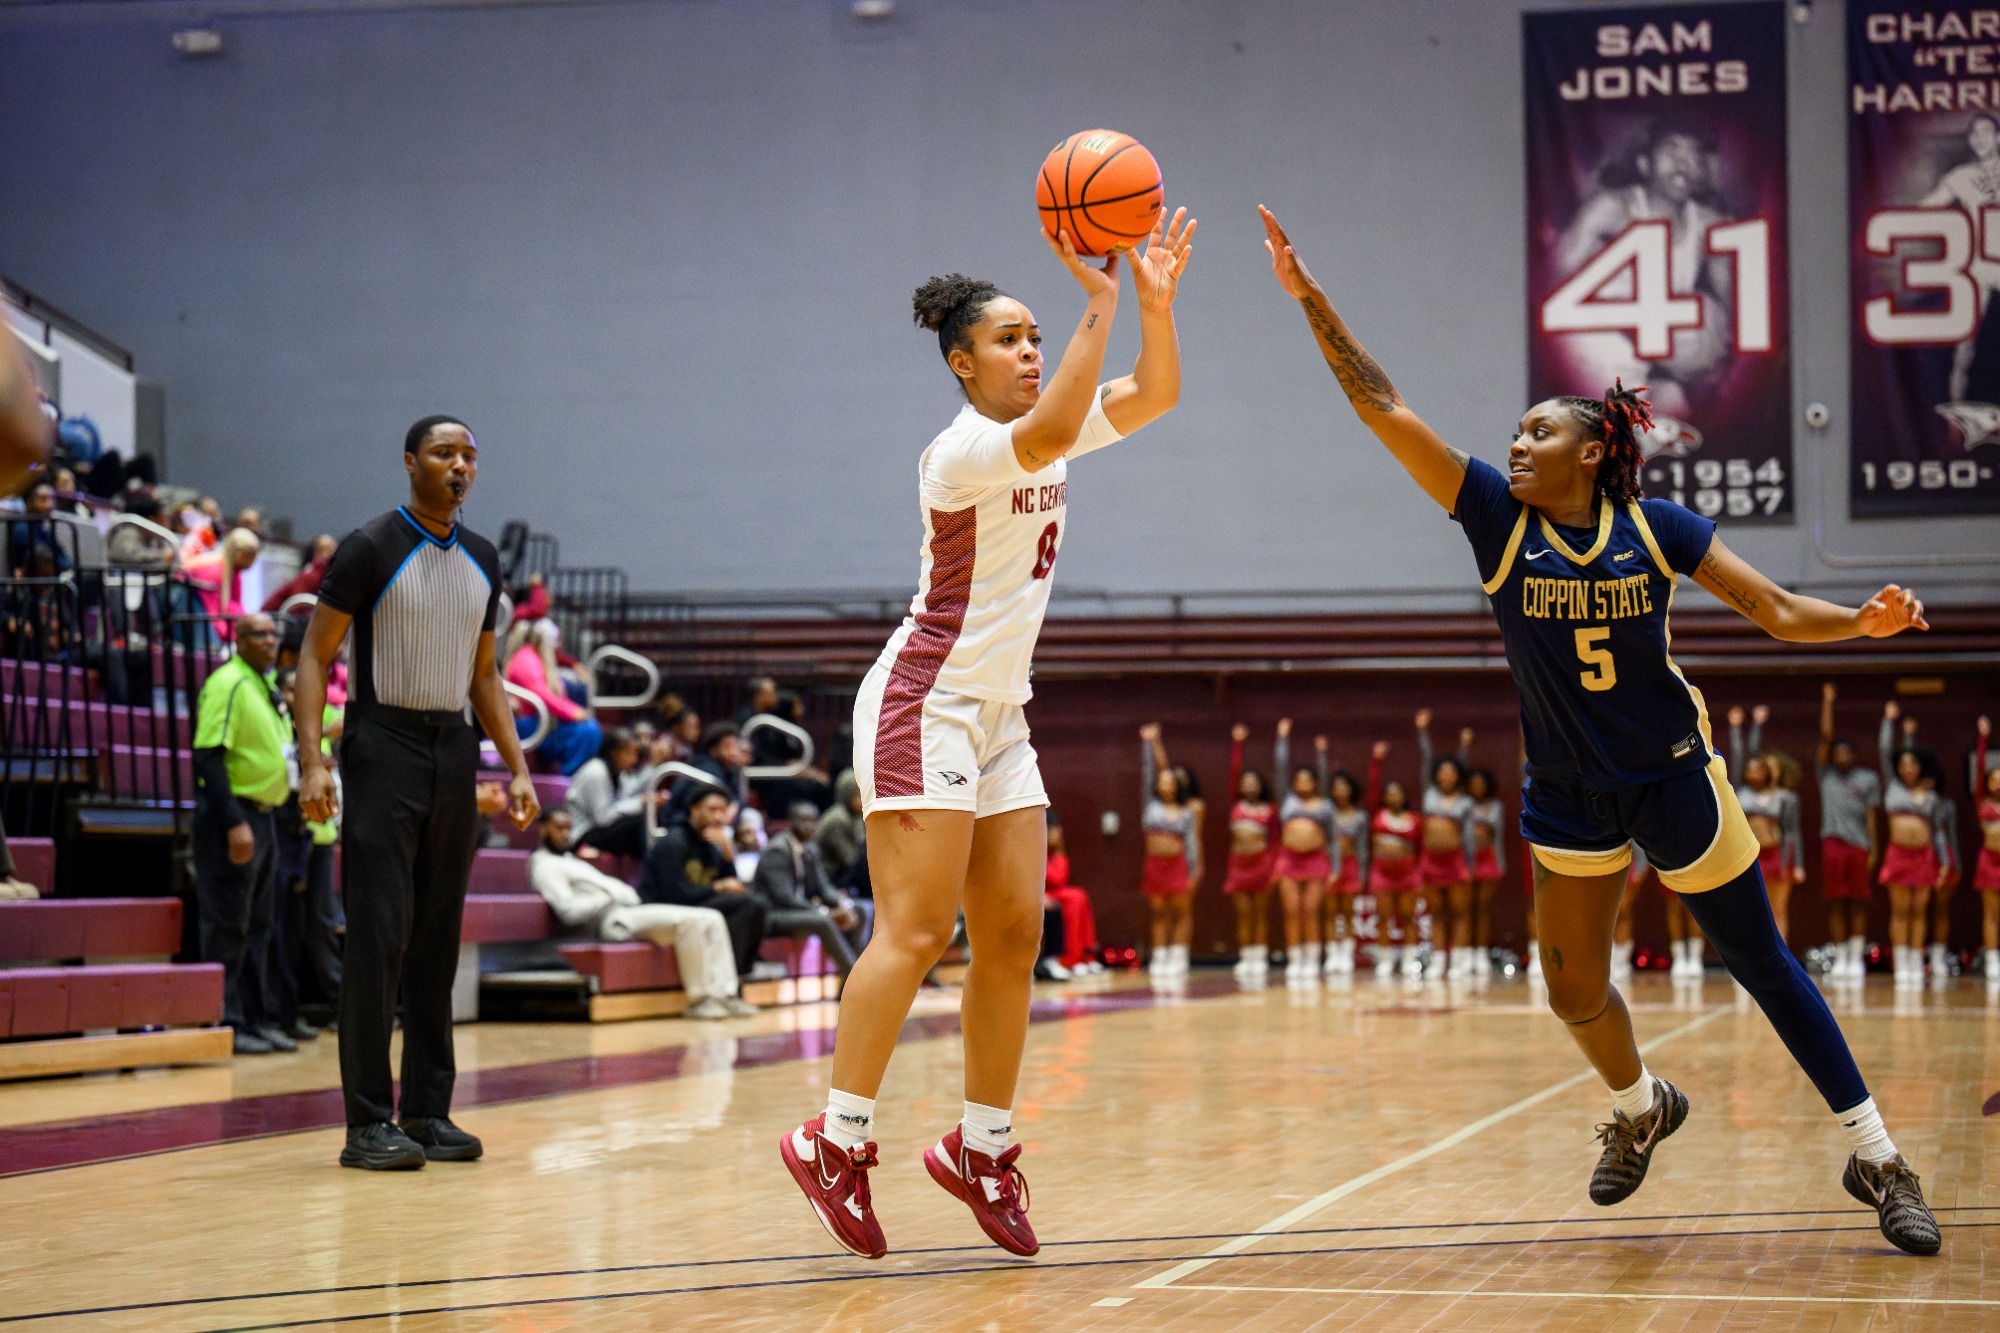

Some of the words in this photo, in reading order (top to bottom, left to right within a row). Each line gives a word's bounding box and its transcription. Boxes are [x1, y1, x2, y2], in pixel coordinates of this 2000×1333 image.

[1596, 20, 1712, 57] SAM
[1866, 10, 2000, 43] CHAR
[1559, 60, 1748, 101] JONES
[1913, 44, 2000, 76] “TE
[1541, 217, 1774, 360] 41
[1012, 487, 1034, 514] NC
[1031, 521, 1058, 580] 0
[1523, 577, 1588, 620] COPPIN
[1595, 573, 1653, 620] STATE
[1574, 626, 1617, 692] 5
